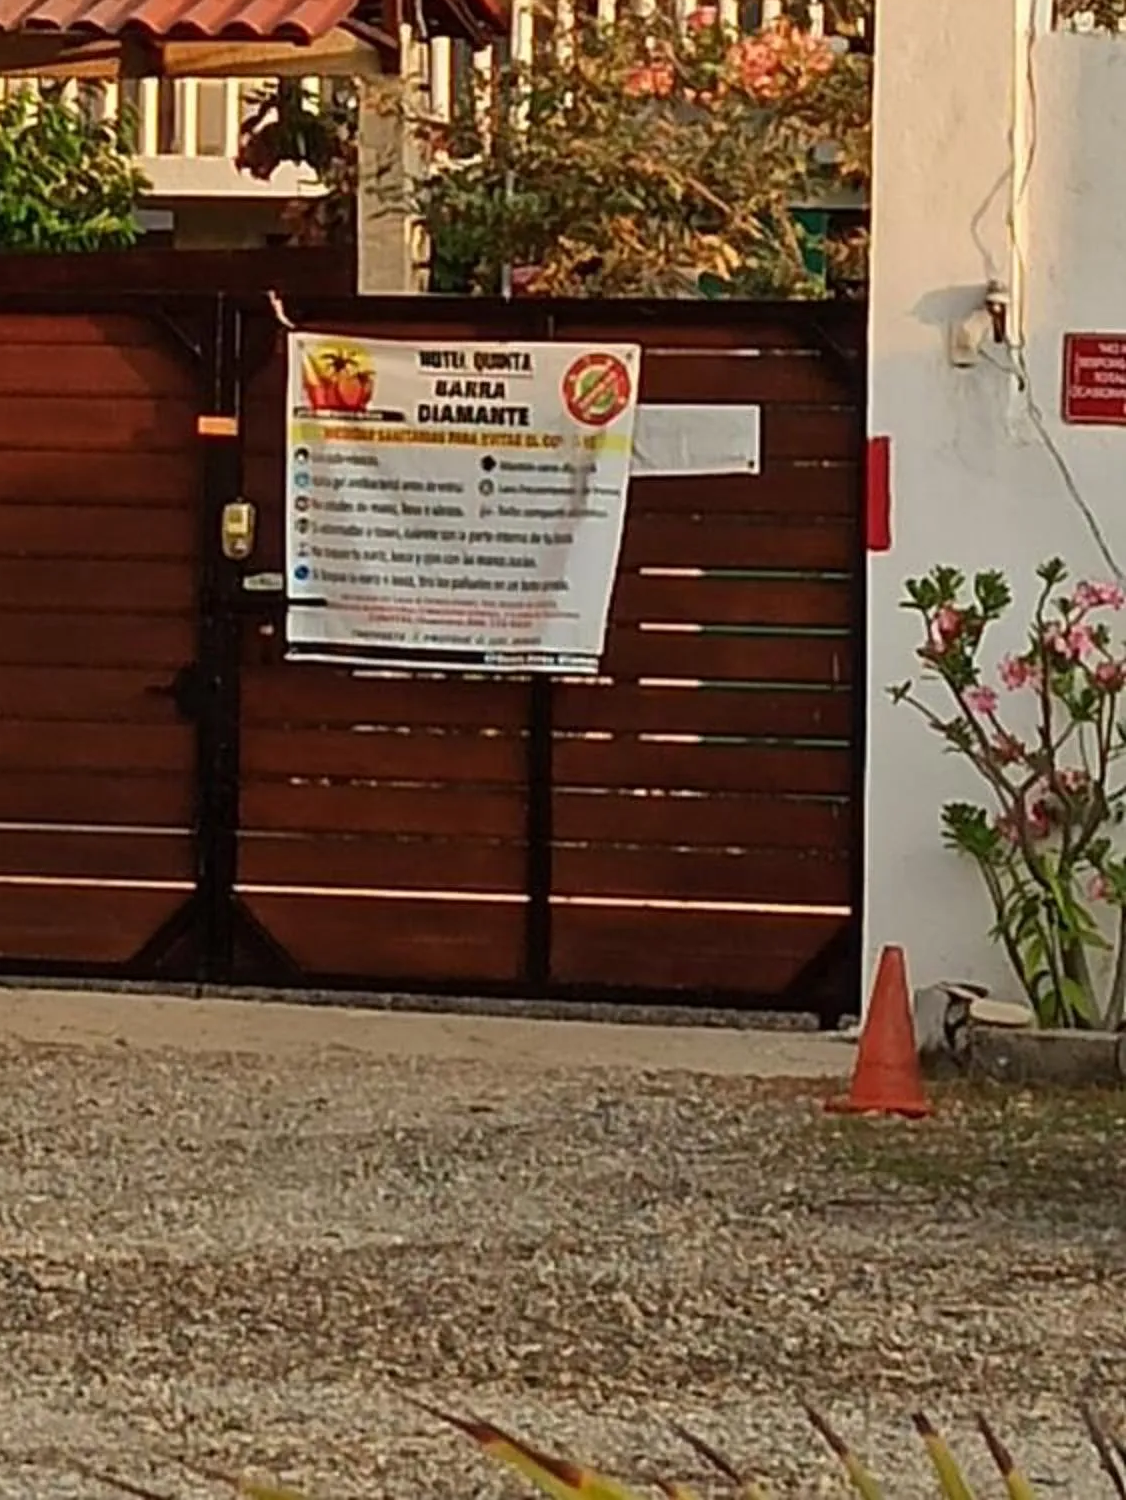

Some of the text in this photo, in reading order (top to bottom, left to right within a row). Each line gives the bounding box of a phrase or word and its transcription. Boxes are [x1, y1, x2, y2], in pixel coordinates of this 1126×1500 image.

[473, 351, 532, 372] QUINTA
[435, 380, 505, 399] BARRA
[417, 403, 530, 427] DIAMANTE
